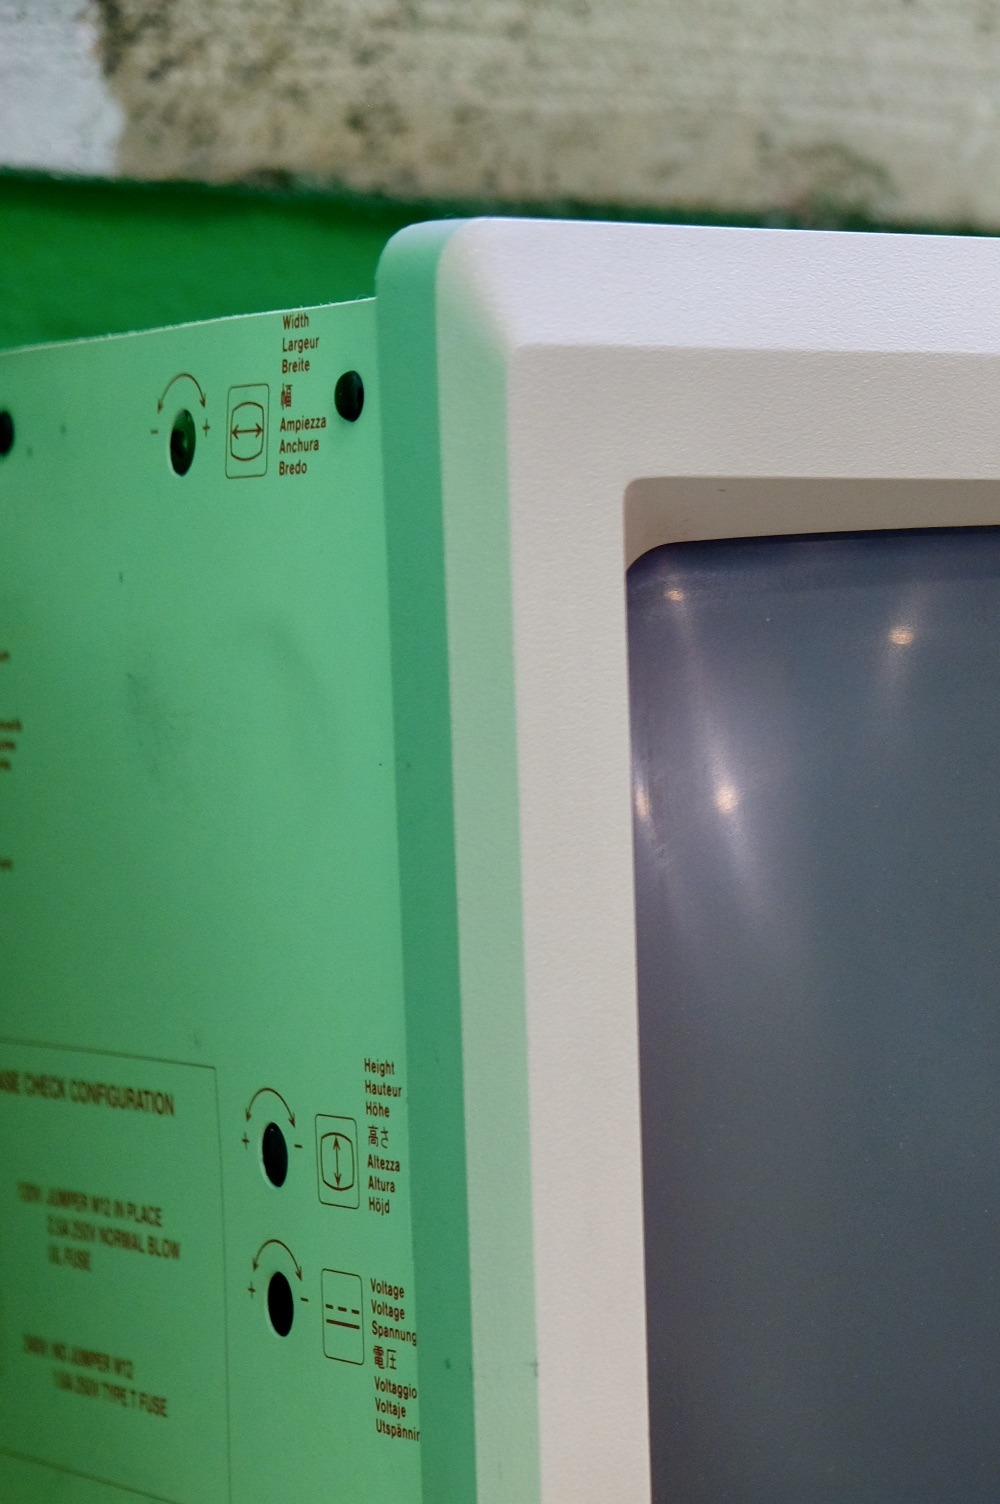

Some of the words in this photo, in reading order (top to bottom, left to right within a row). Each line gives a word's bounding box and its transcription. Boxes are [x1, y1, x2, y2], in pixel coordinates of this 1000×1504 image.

[282, 313, 309, 330] Width
[282, 337, 320, 353] Largeur
[281, 359, 310, 374] Breite
[279, 416, 327, 434] Ampiezza
[279, 439, 319, 454] Anchura
[278, 461, 308, 476] Bredo
[364, 1058, 395, 1078] Height
[71, 1078, 175, 1116] CONFIGURATION
[364, 1080, 402, 1097] Hauteur
[365, 1101, 390, 1118] Höhe
[368, 1125, 389, 1149] 高さ
[367, 1154, 401, 1172] Altezza
[368, 1175, 396, 1193] Altura
[127, 1201, 162, 1228] PLACE
[368, 1197, 390, 1216] Höjd
[370, 1278, 405, 1300] Voltage
[371, 1299, 405, 1322] Voltage
[371, 1320, 417, 1347] Spannung
[373, 1345, 397, 1370] 電圧
[374, 1376, 418, 1400] Voltaggio
[374, 1397, 406, 1420] Voltaje
